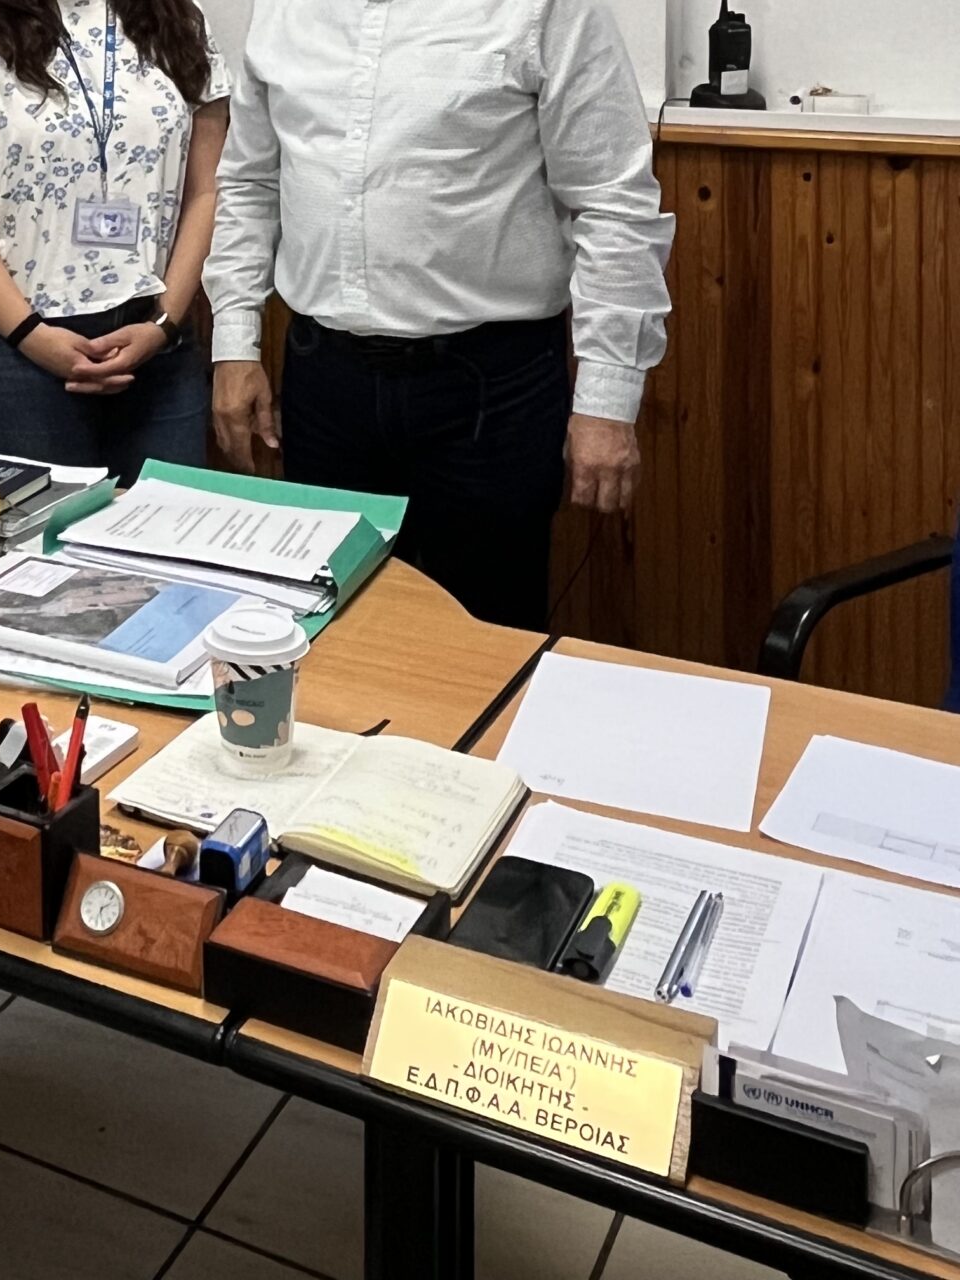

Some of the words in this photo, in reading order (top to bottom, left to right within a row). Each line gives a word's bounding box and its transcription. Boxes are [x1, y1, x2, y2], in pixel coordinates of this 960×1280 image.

[425, 997, 536, 1046] ΙΑΚΩΒΙΔΗΣ
[542, 1033, 638, 1078] ΙΩΑΝΝΗΣ
[406, 1065, 527, 1120] Ε.Δ.Π.Φ.Α.Α.
[535, 1108, 630, 1155] ΒΕΡΟΙΑΣ
[463, 1061, 576, 1112] ΔΙΟΙΚΗΤΗΣ
